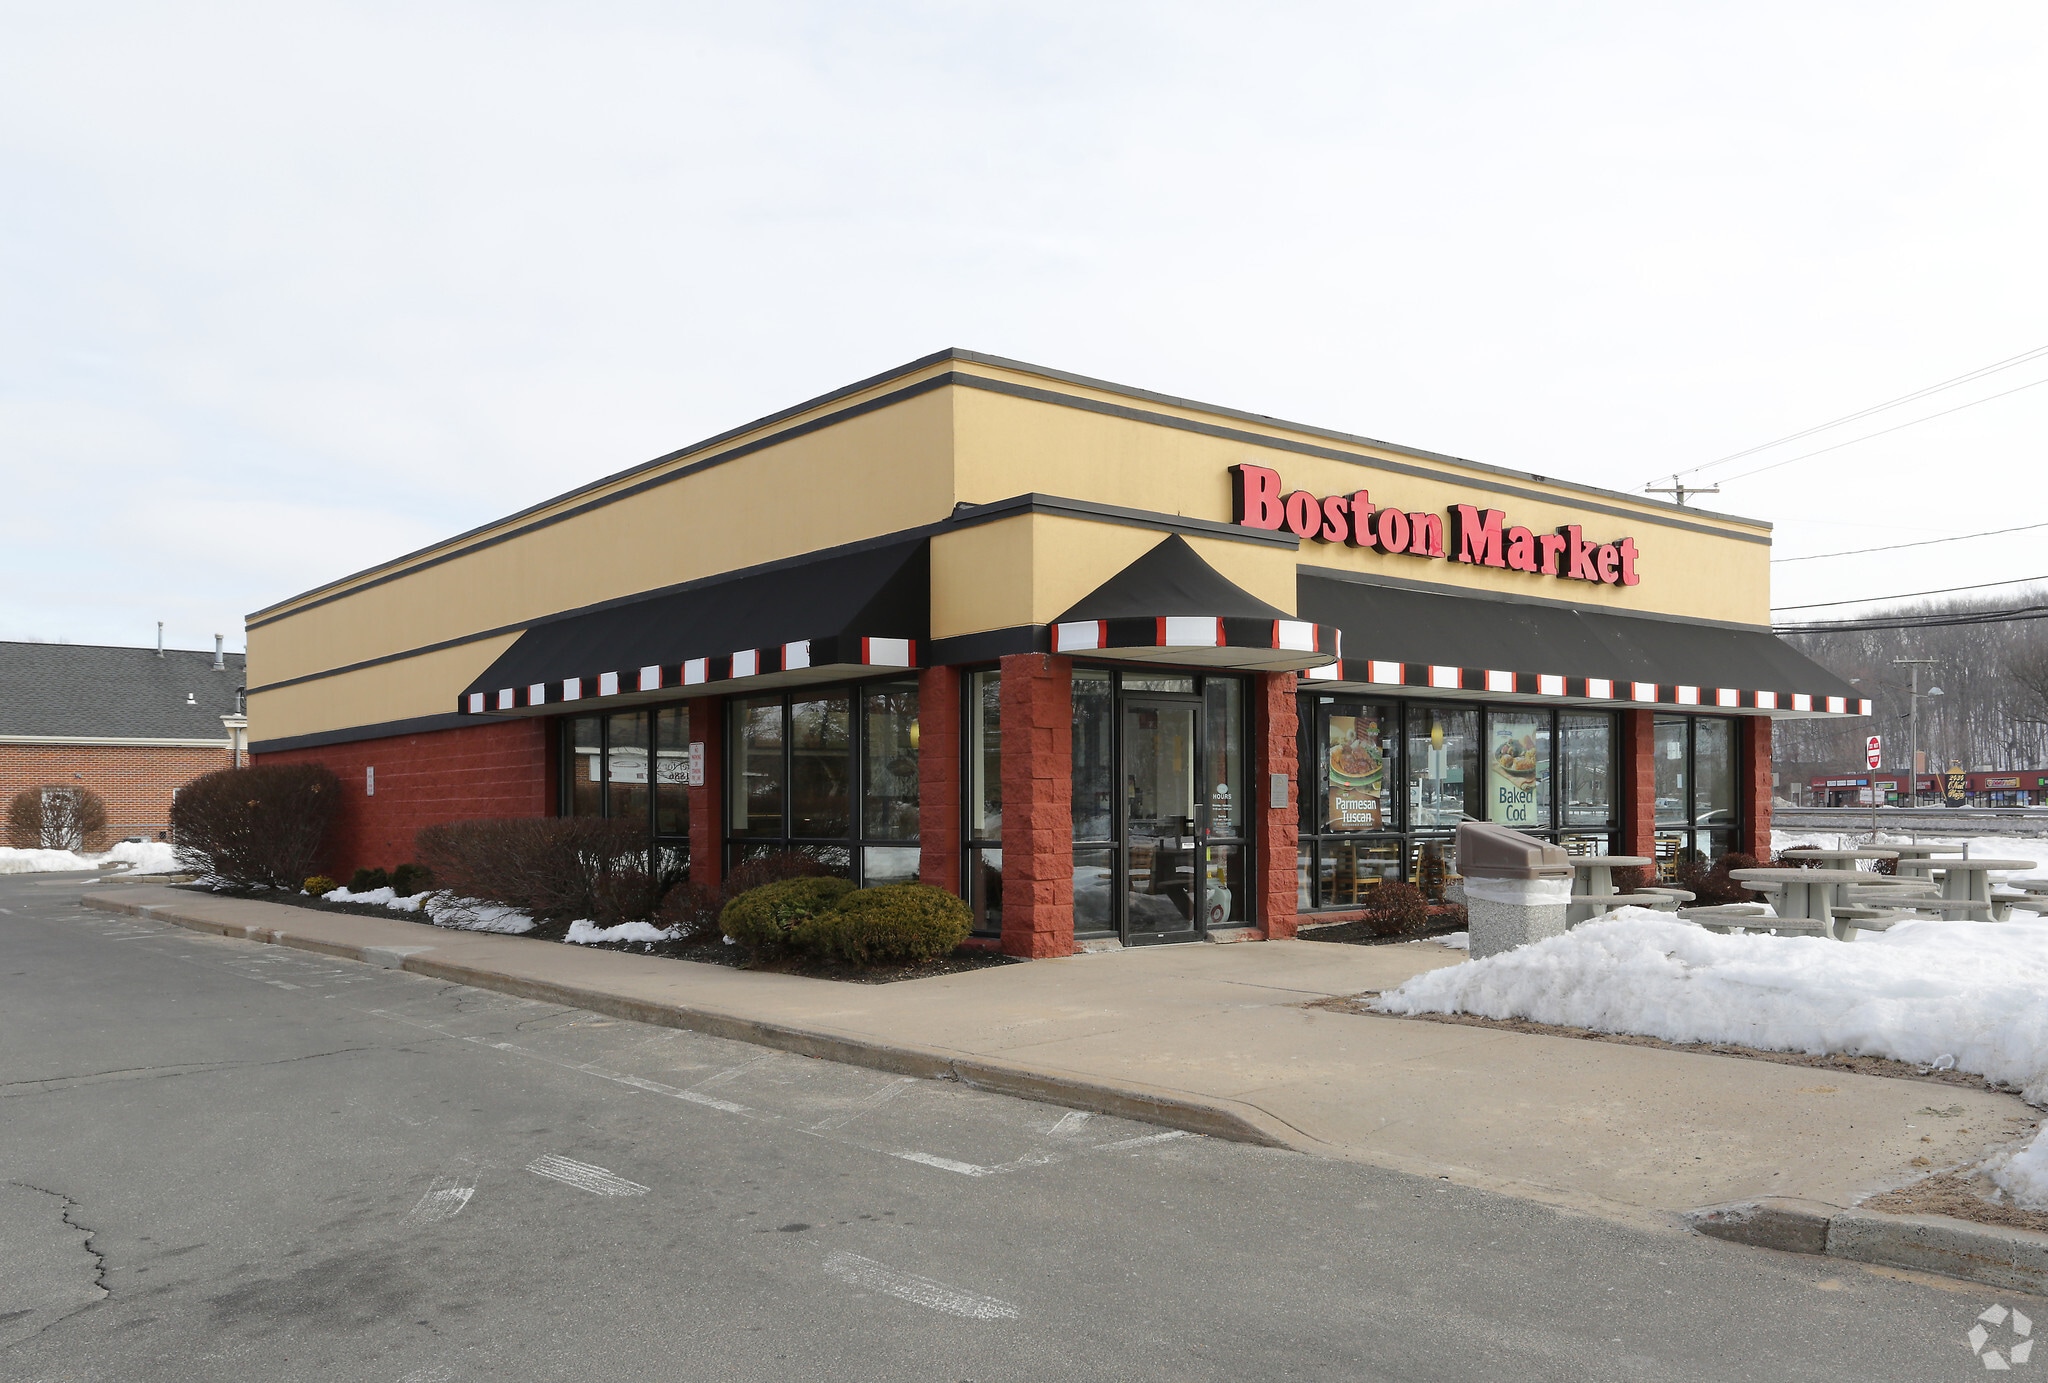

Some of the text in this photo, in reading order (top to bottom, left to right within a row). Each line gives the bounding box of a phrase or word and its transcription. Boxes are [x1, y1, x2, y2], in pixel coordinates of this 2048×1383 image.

[1229, 463, 1640, 586] Boston Market
[1499, 786, 1533, 803] Baked
[1335, 797, 1377, 810] Parmesan
[1341, 810, 1372, 823] Tuscan
[1506, 804, 1527, 821] Cod
